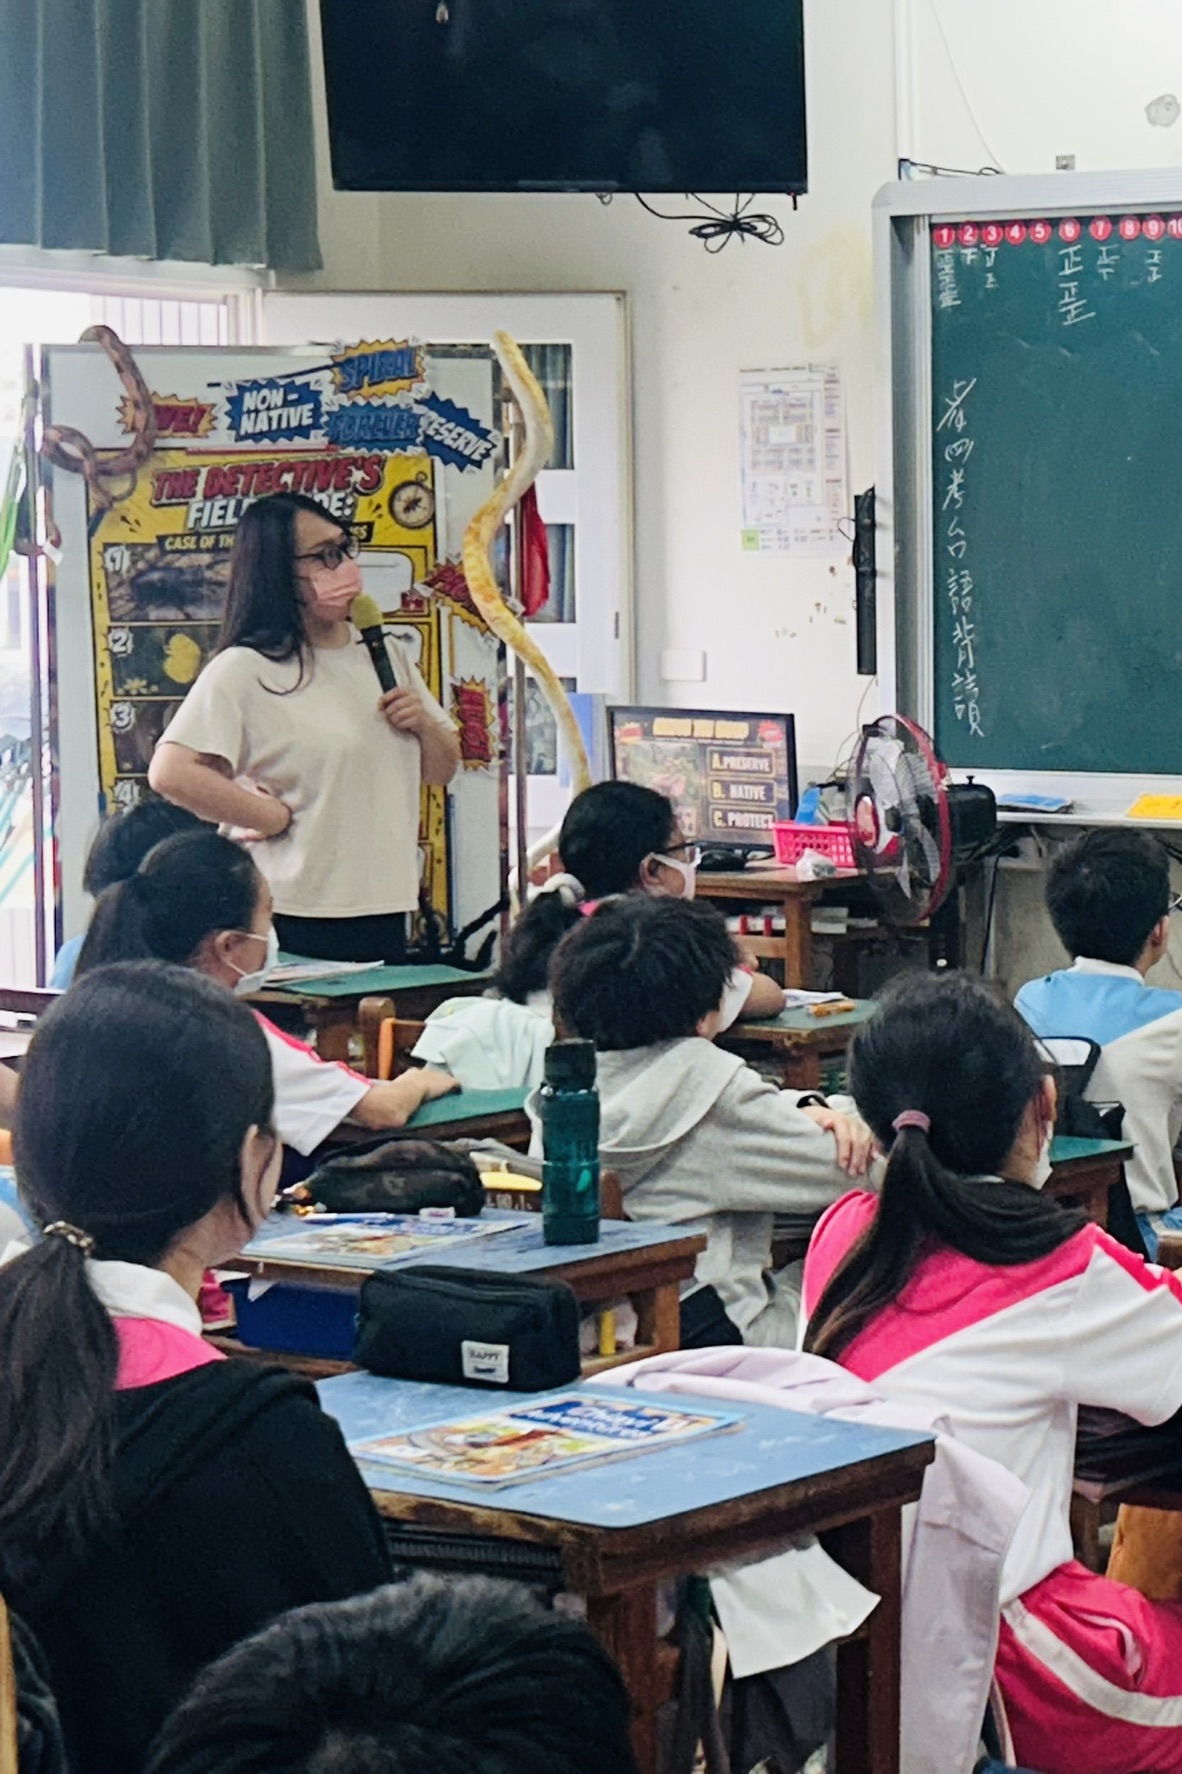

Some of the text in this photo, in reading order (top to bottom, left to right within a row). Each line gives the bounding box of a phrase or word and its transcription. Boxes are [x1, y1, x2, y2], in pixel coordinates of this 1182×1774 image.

[941, 228, 949, 243] 1
[963, 225, 974, 240] 2
[987, 225, 997, 241] 3
[1010, 224, 1020, 239] 4
[1035, 223, 1046, 238] 5
[1064, 221, 1075, 237] 6
[1095, 220, 1105, 236] 7
[1125, 219, 1135, 235] 8
[1149, 219, 1159, 235] 9
[240, 402, 314, 436] NATIVE
[153, 455, 384, 502] THE DETECTIVE'S
[165, 533, 236, 550] CASE OF TH
[112, 632, 129, 650] 2
[114, 706, 130, 727] 3
[722, 756, 771, 772] PRESERVE
[729, 784, 767, 801] NATIVE
